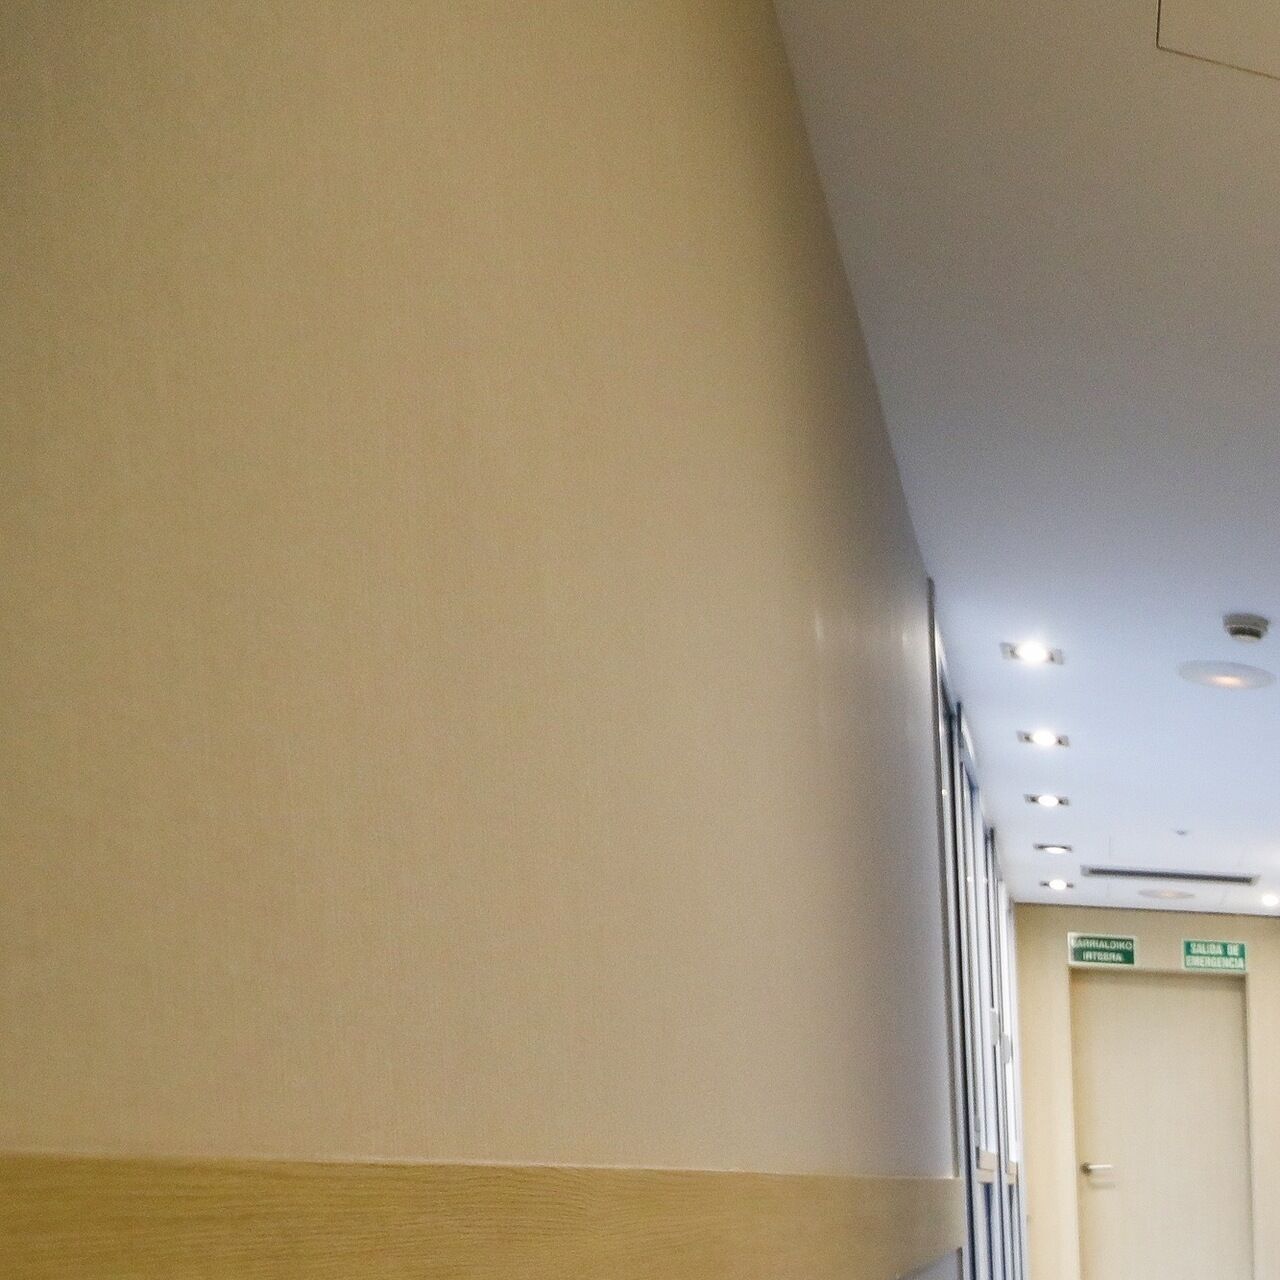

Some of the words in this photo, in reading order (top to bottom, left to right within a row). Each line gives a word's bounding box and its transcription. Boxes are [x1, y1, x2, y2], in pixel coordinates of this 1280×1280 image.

[1190, 942, 1222, 955] SALIDA
[1227, 943, 1239, 956] DE
[1185, 956, 1244, 969] EMERGENCIA
